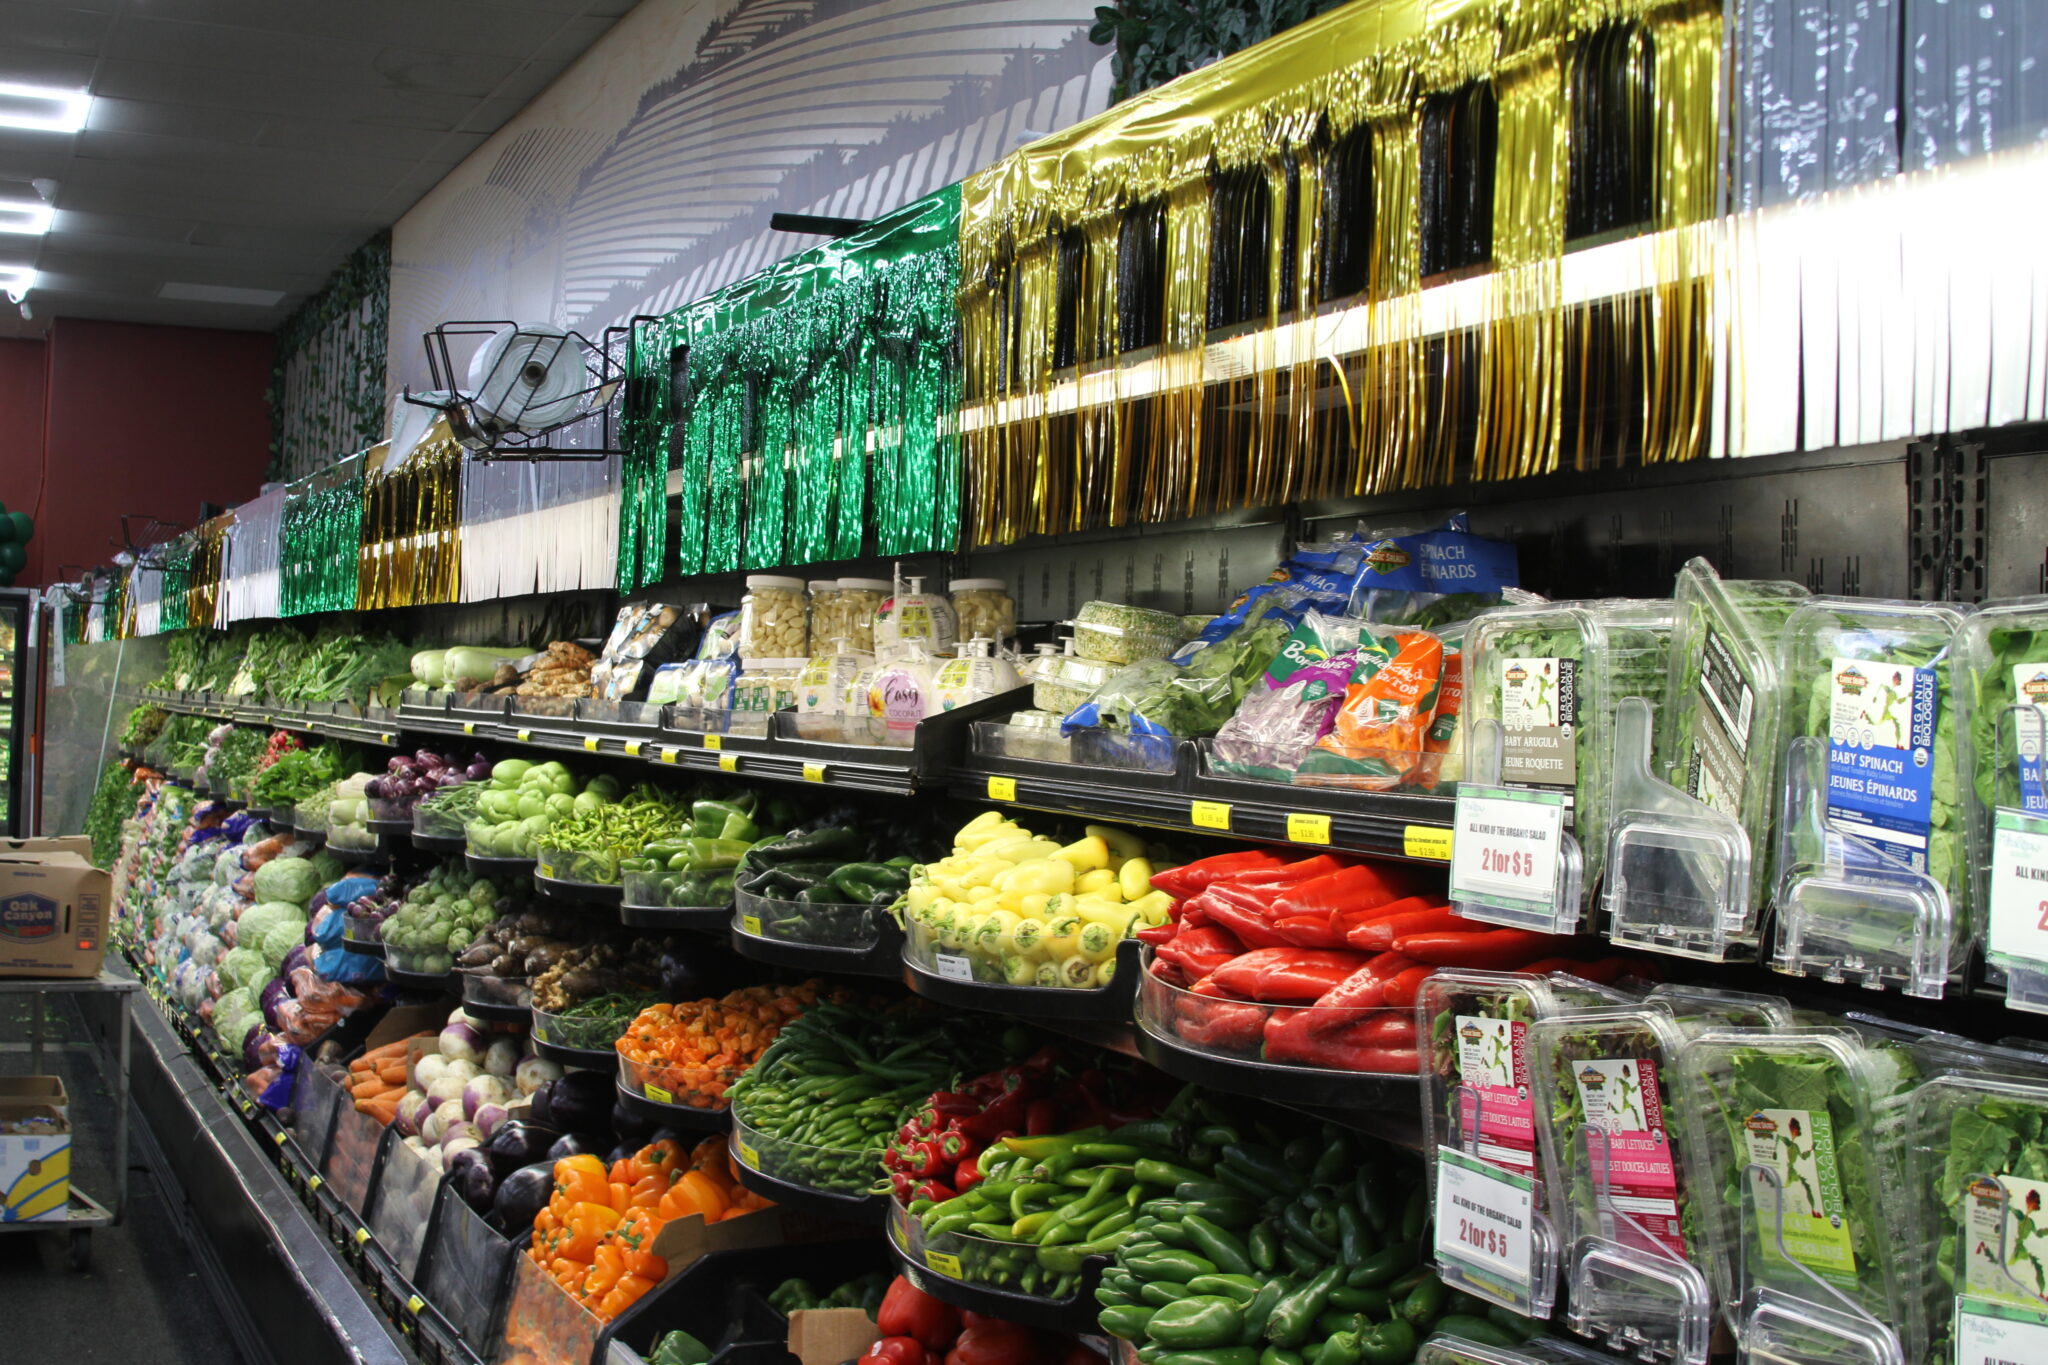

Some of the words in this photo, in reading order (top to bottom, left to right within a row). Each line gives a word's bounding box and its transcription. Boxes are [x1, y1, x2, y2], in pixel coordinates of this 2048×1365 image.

[885, 677, 919, 708] Easy
[1566, 661, 1574, 722] BIOLOGIQUE
[1912, 673, 1924, 745] ORGANIC
[1922, 673, 1934, 746] BIOLOGIQUE
[1504, 735, 1522, 747] BABY
[1523, 736, 1559, 749] ARUGULA
[1504, 756, 1524, 768] JEUNE
[1525, 757, 1564, 770] ROQUETTE
[1831, 749, 1857, 765] BABY
[1859, 754, 1904, 774] SPINACH
[1829, 775, 1864, 793] JEUNES
[1866, 779, 1917, 802] ÉPINARDS
[1469, 822, 1478, 832] ALL
[1479, 823, 1490, 834] KIND
[1490, 825, 1497, 835] OF
[1496, 826, 1506, 836] THE
[1506, 827, 1529, 839] ORGANIC
[1529, 829, 1546, 840] SALAD
[1482, 847, 1490, 871] 2
[1492, 849, 1510, 873] for
[2015, 865, 2028, 879] ALL
[3, 911, 53, 921] Canyon
[9, 900, 39, 911] Oak
[1512, 1025, 1522, 1084] ORGANIC
[1519, 1025, 1529, 1084] BIOLOGIQUE
[1494, 1094, 1518, 1106] LETTUCES
[1640, 1063, 1654, 1126] ORGANIC
[1648, 1063, 1662, 1127] BIOLOGIQUE
[1611, 1137, 1626, 1149] BABY
[1627, 1139, 1656, 1151] LETTUCES
[1811, 1116, 1833, 1212] ORGANIC
[1821, 1116, 1843, 1213] BIOLOGIQUE
[1452, 1194, 1461, 1206] ALL
[1461, 1197, 1471, 1211] KIND
[1471, 1201, 1477, 1212] OF
[1477, 1204, 1486, 1217] THE
[1485, 1207, 1507, 1224] ORGANIC
[1507, 1215, 1522, 1230] SALAD
[1459, 1218, 1467, 1241] 2
[1469, 1222, 1486, 1250] for
